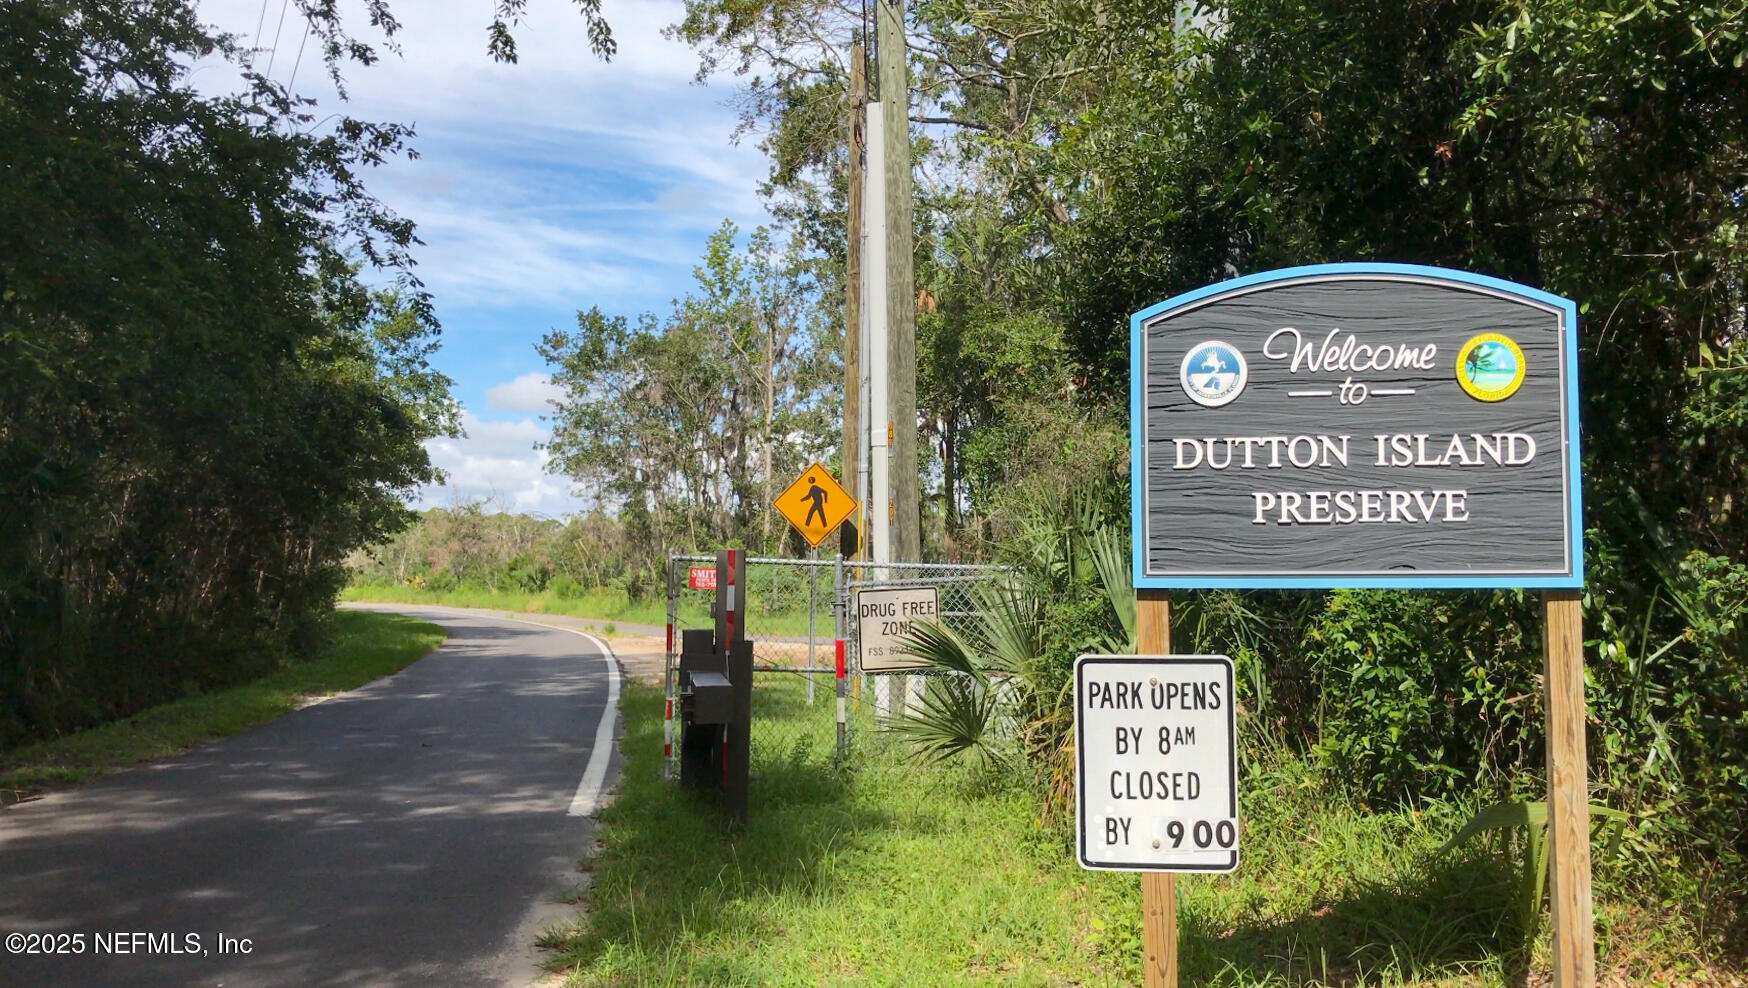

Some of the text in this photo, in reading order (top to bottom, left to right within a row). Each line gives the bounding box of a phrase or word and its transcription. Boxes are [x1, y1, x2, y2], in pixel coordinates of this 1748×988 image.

[1263, 327, 1437, 373] Welcome
[1339, 376, 1367, 404] to
[1173, 433, 1537, 470] DUTTON ISLAND
[1252, 489, 1470, 525] PRESERVE
[861, 601, 935, 618] DRUG FREE
[1088, 681, 1221, 710] PARK OPENS
[1116, 727, 1143, 755] BY
[1110, 770, 1200, 800] CLOSED
[1105, 817, 1132, 845] BY
